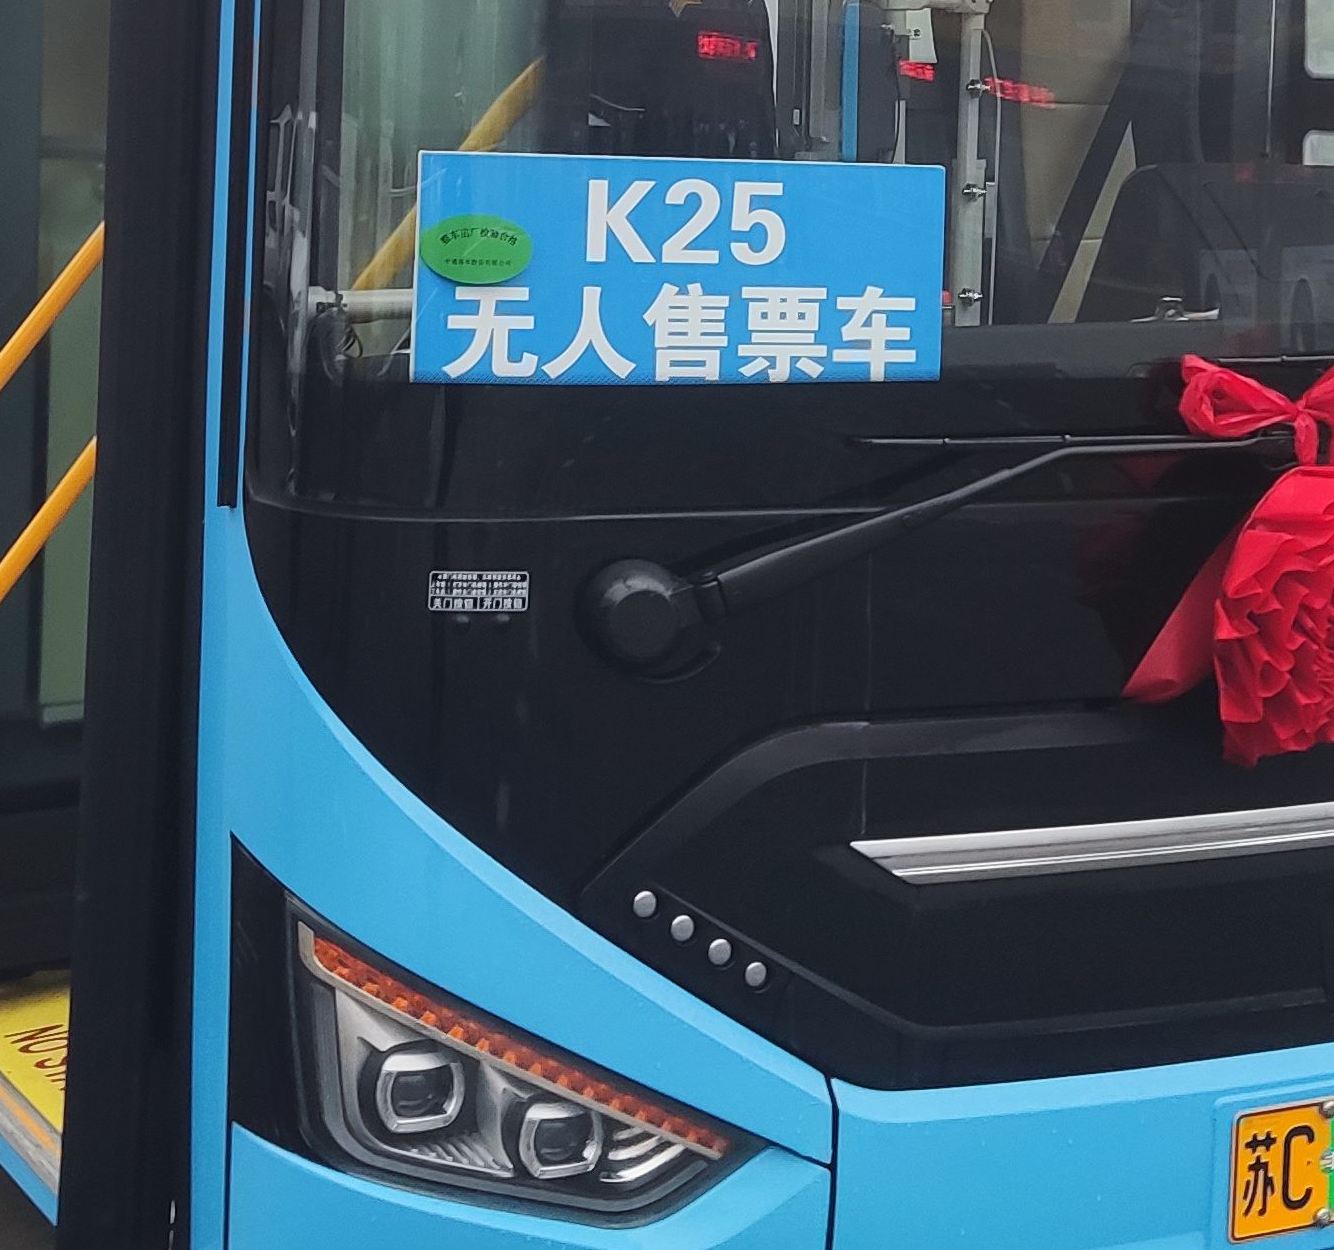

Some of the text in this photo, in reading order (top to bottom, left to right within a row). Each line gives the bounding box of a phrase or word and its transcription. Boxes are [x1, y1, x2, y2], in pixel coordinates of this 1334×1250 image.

[585, 179, 786, 265] K25
[443, 283, 917, 383] 无人售票车
